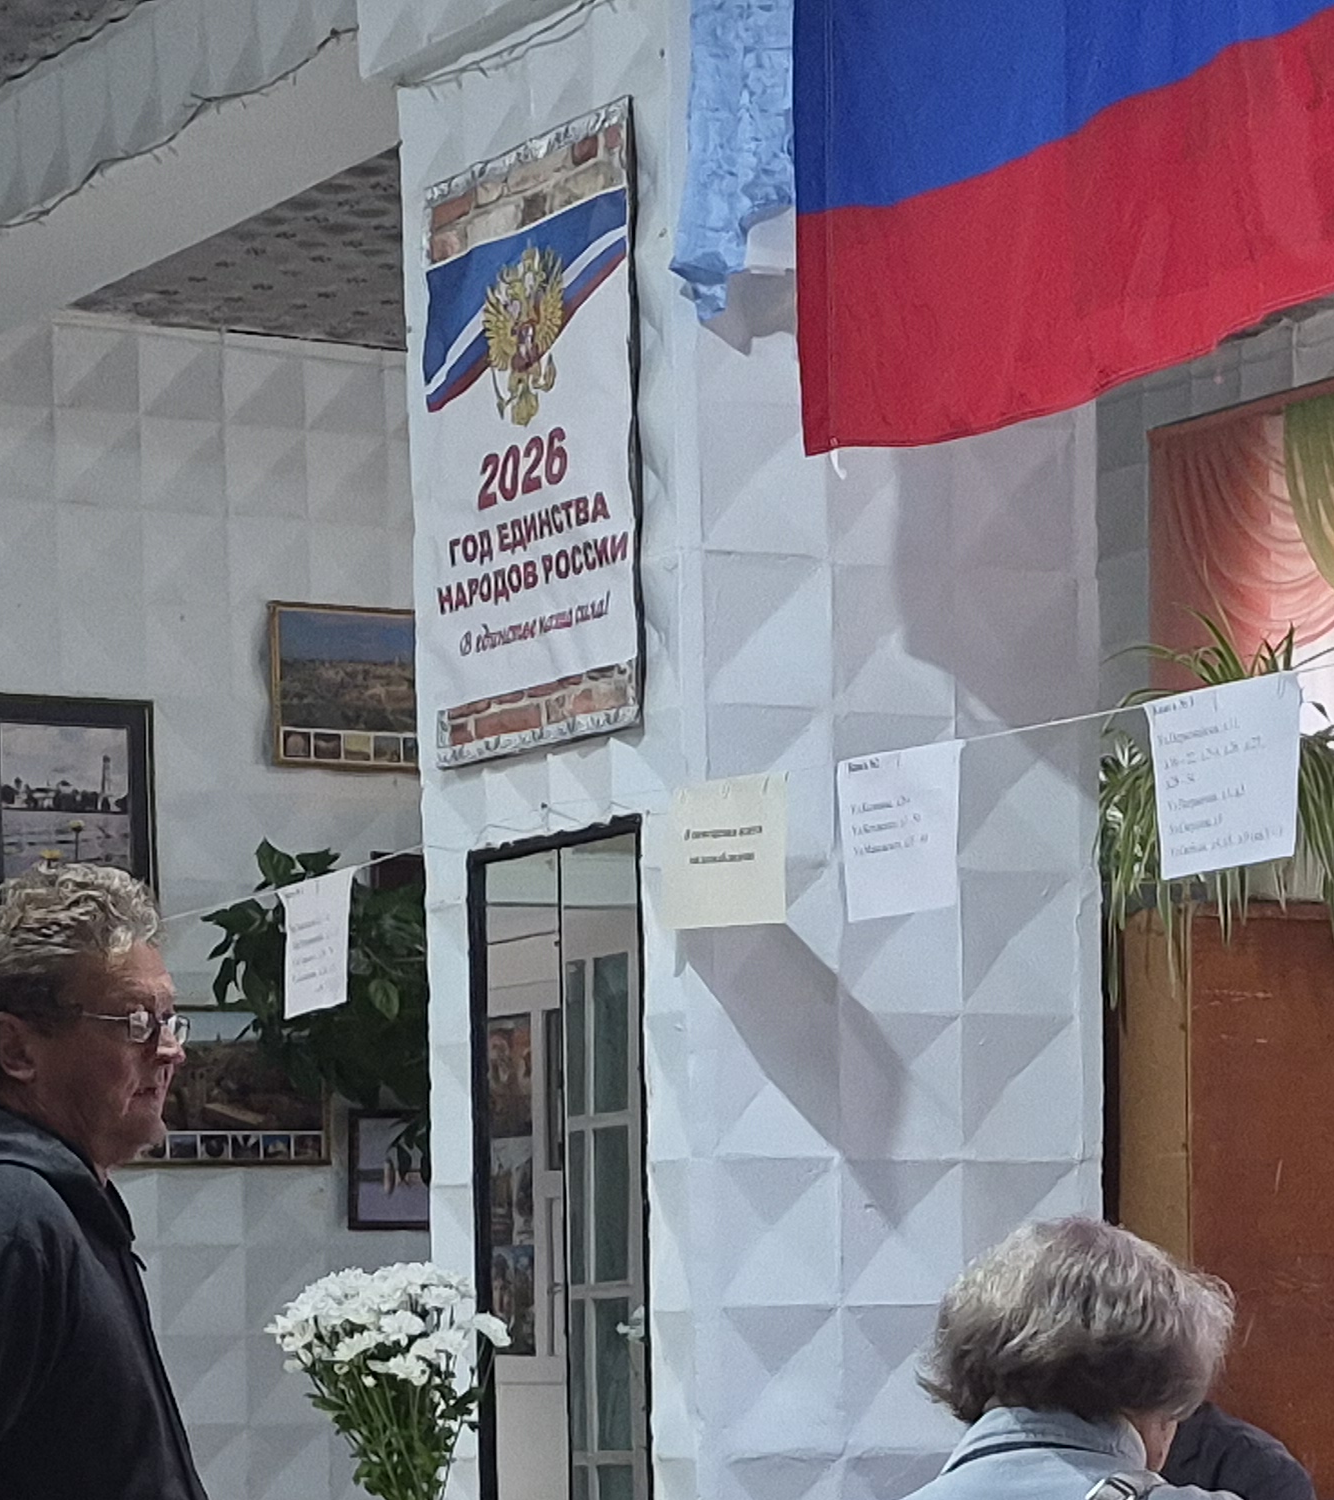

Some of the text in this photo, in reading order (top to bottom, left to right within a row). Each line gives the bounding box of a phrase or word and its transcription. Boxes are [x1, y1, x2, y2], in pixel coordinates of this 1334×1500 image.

[478, 427, 568, 511] 2026
[449, 492, 610, 567] ГОД ЕДИНСТВА
[437, 532, 628, 615] НАРОДОВ РОССИИ
